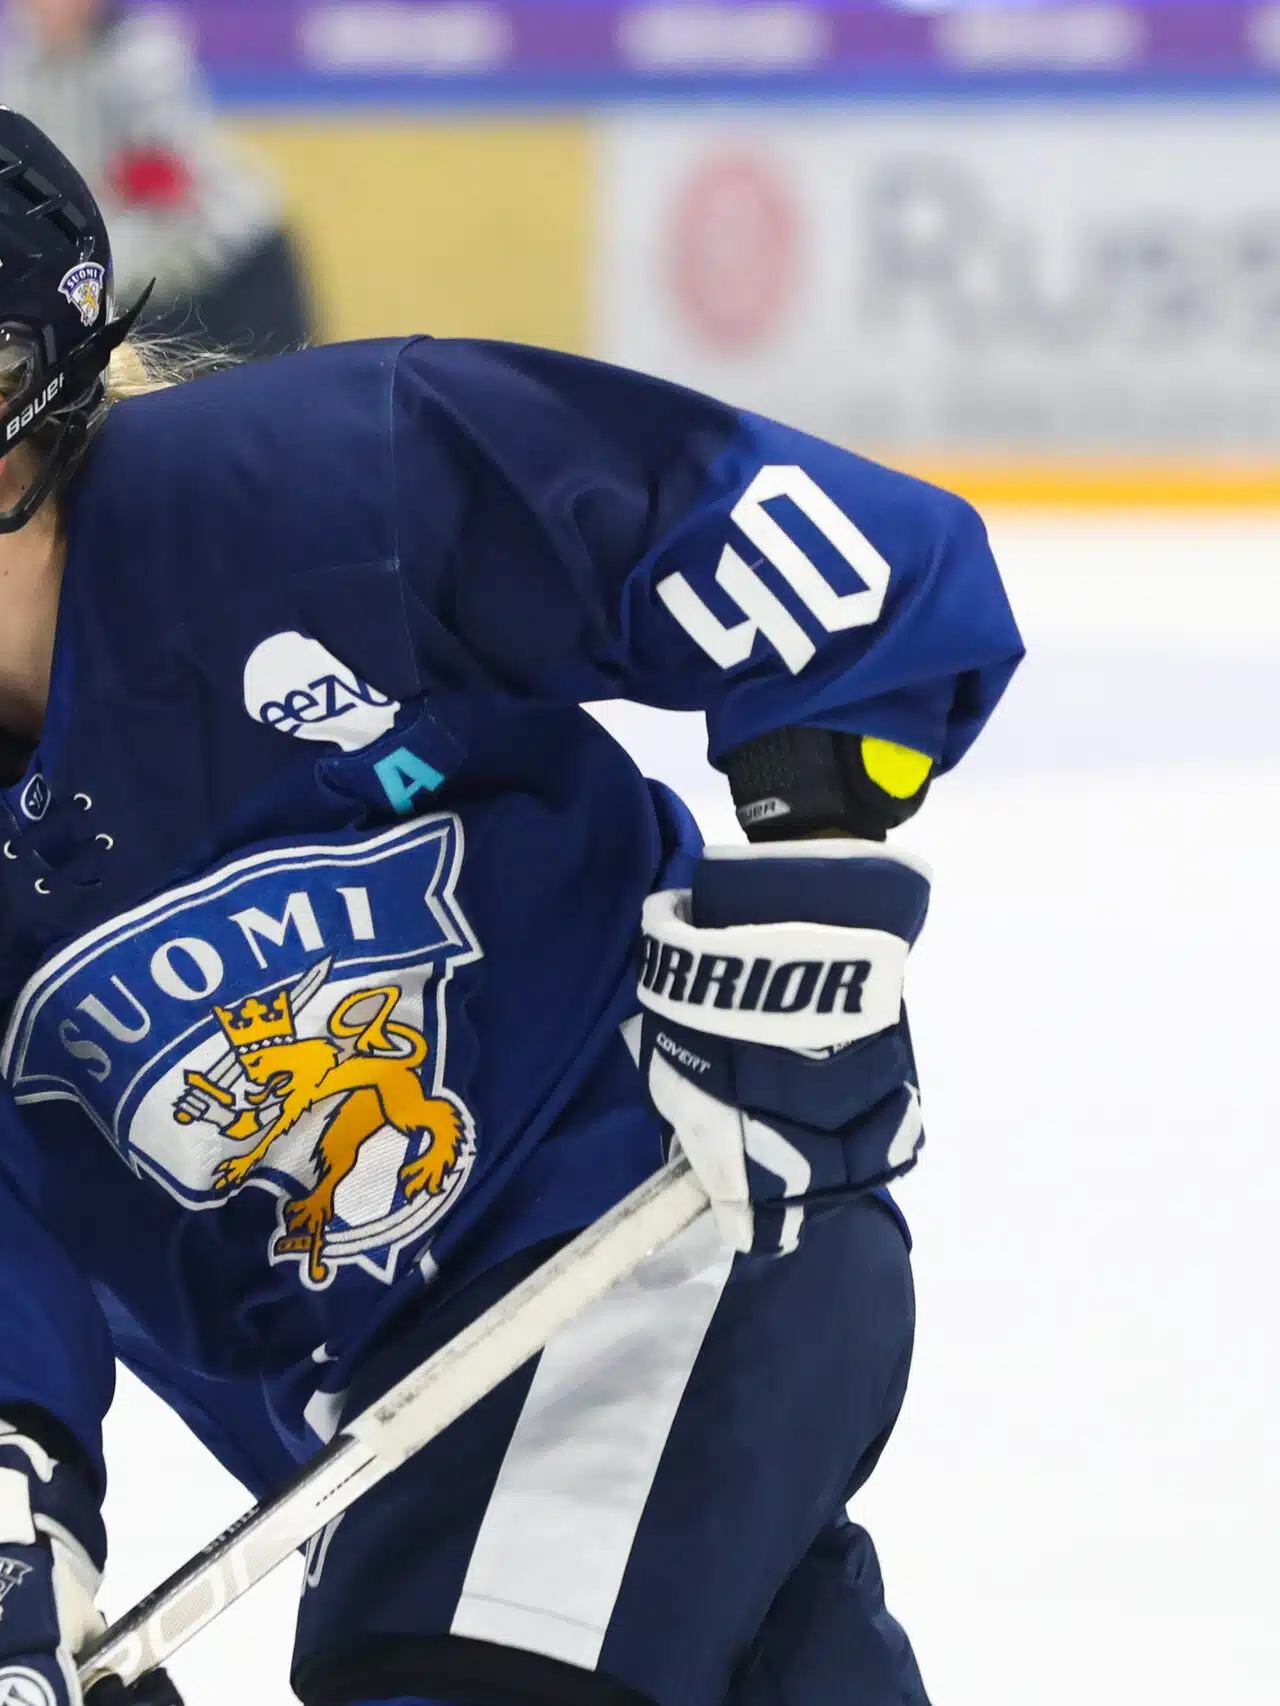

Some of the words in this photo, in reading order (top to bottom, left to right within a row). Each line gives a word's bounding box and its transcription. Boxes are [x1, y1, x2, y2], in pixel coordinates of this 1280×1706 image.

[66, 268, 98, 290] SUOMI
[656, 465, 891, 675] 40
[373, 746, 446, 815] A
[59, 886, 376, 1083] SUOMI
[656, 1031, 712, 1074] COVERT
